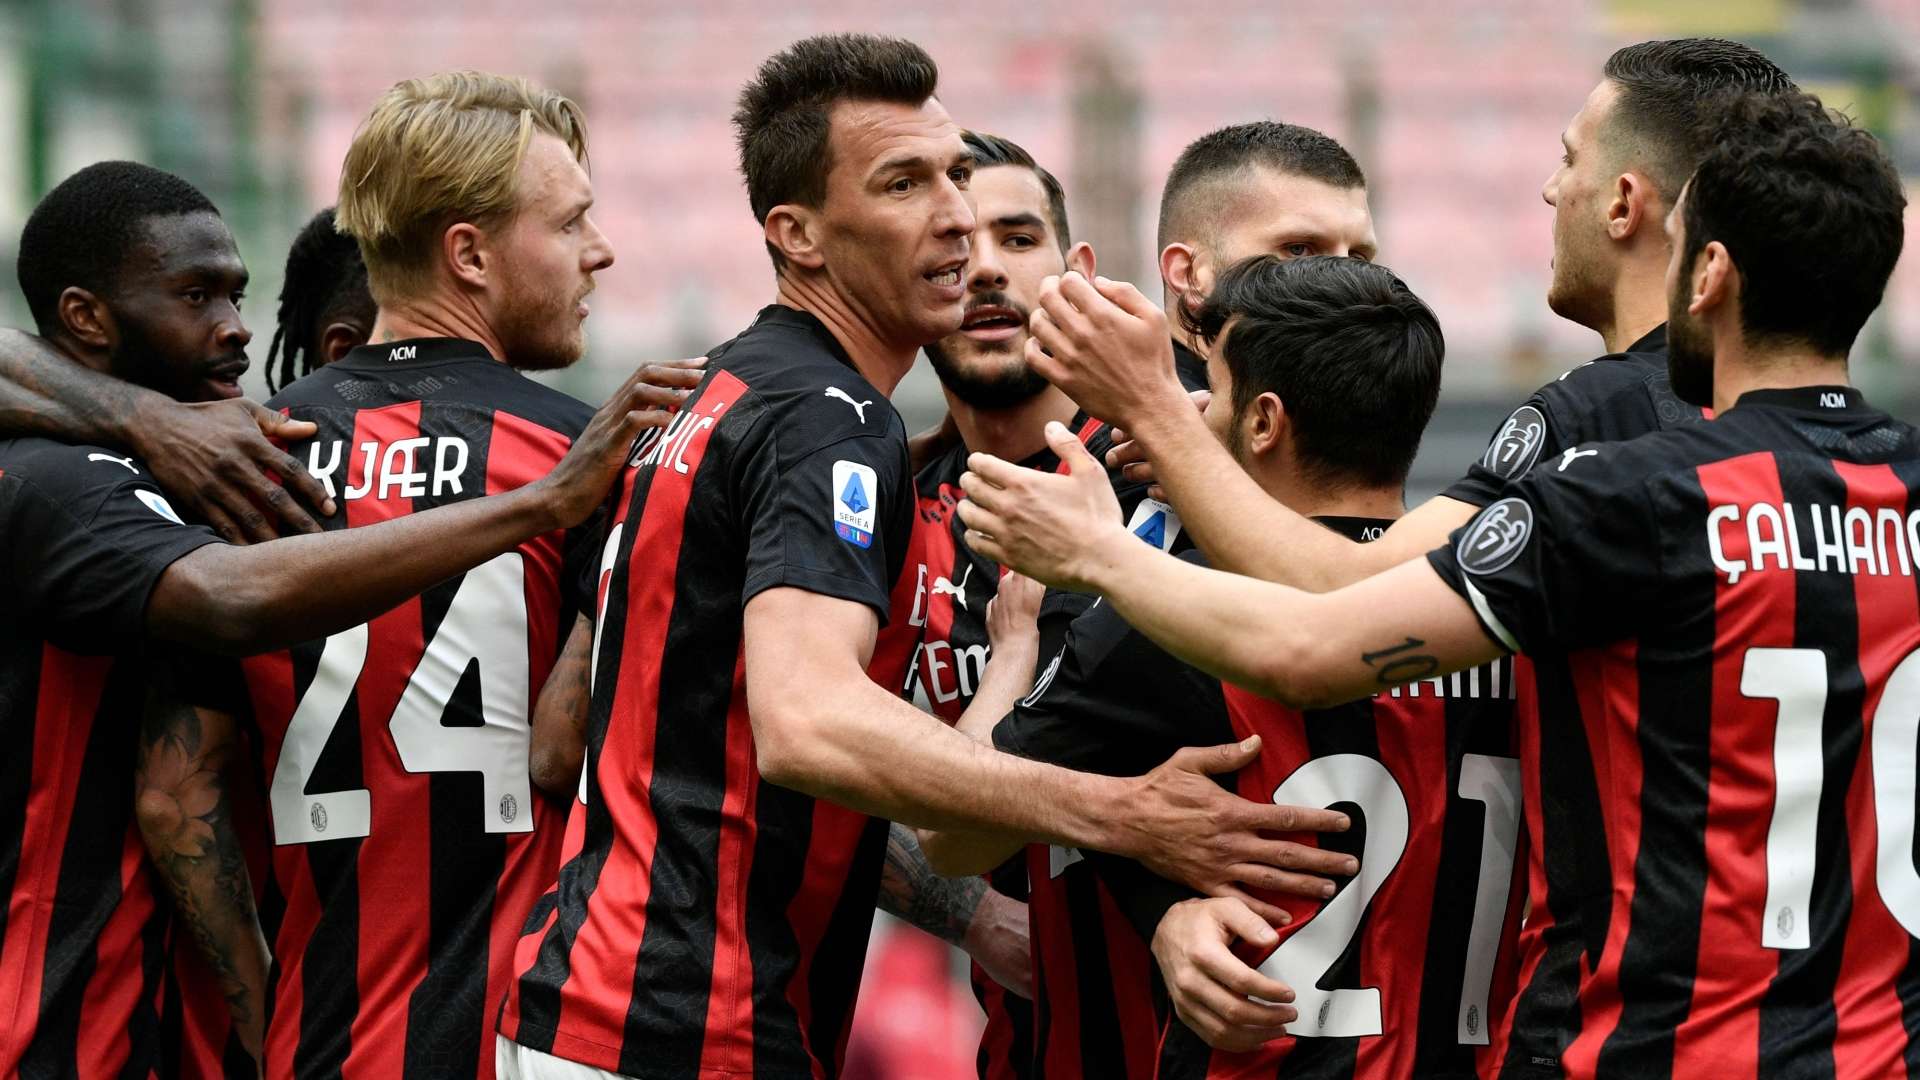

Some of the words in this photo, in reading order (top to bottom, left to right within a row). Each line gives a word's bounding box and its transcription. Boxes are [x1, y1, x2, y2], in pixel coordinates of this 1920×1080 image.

[388, 345, 417, 361] ACM
[1819, 393, 1846, 408] ACM
[629, 402, 725, 475] UKIĆ
[1502, 442, 1519, 463] 7
[308, 436, 469, 500] KJÆR
[839, 512, 862, 526] SERIE
[1477, 530, 1500, 551] 7
[1361, 636, 1439, 685] 10
[269, 552, 535, 845] 24
[1248, 753, 1522, 1045] 21
